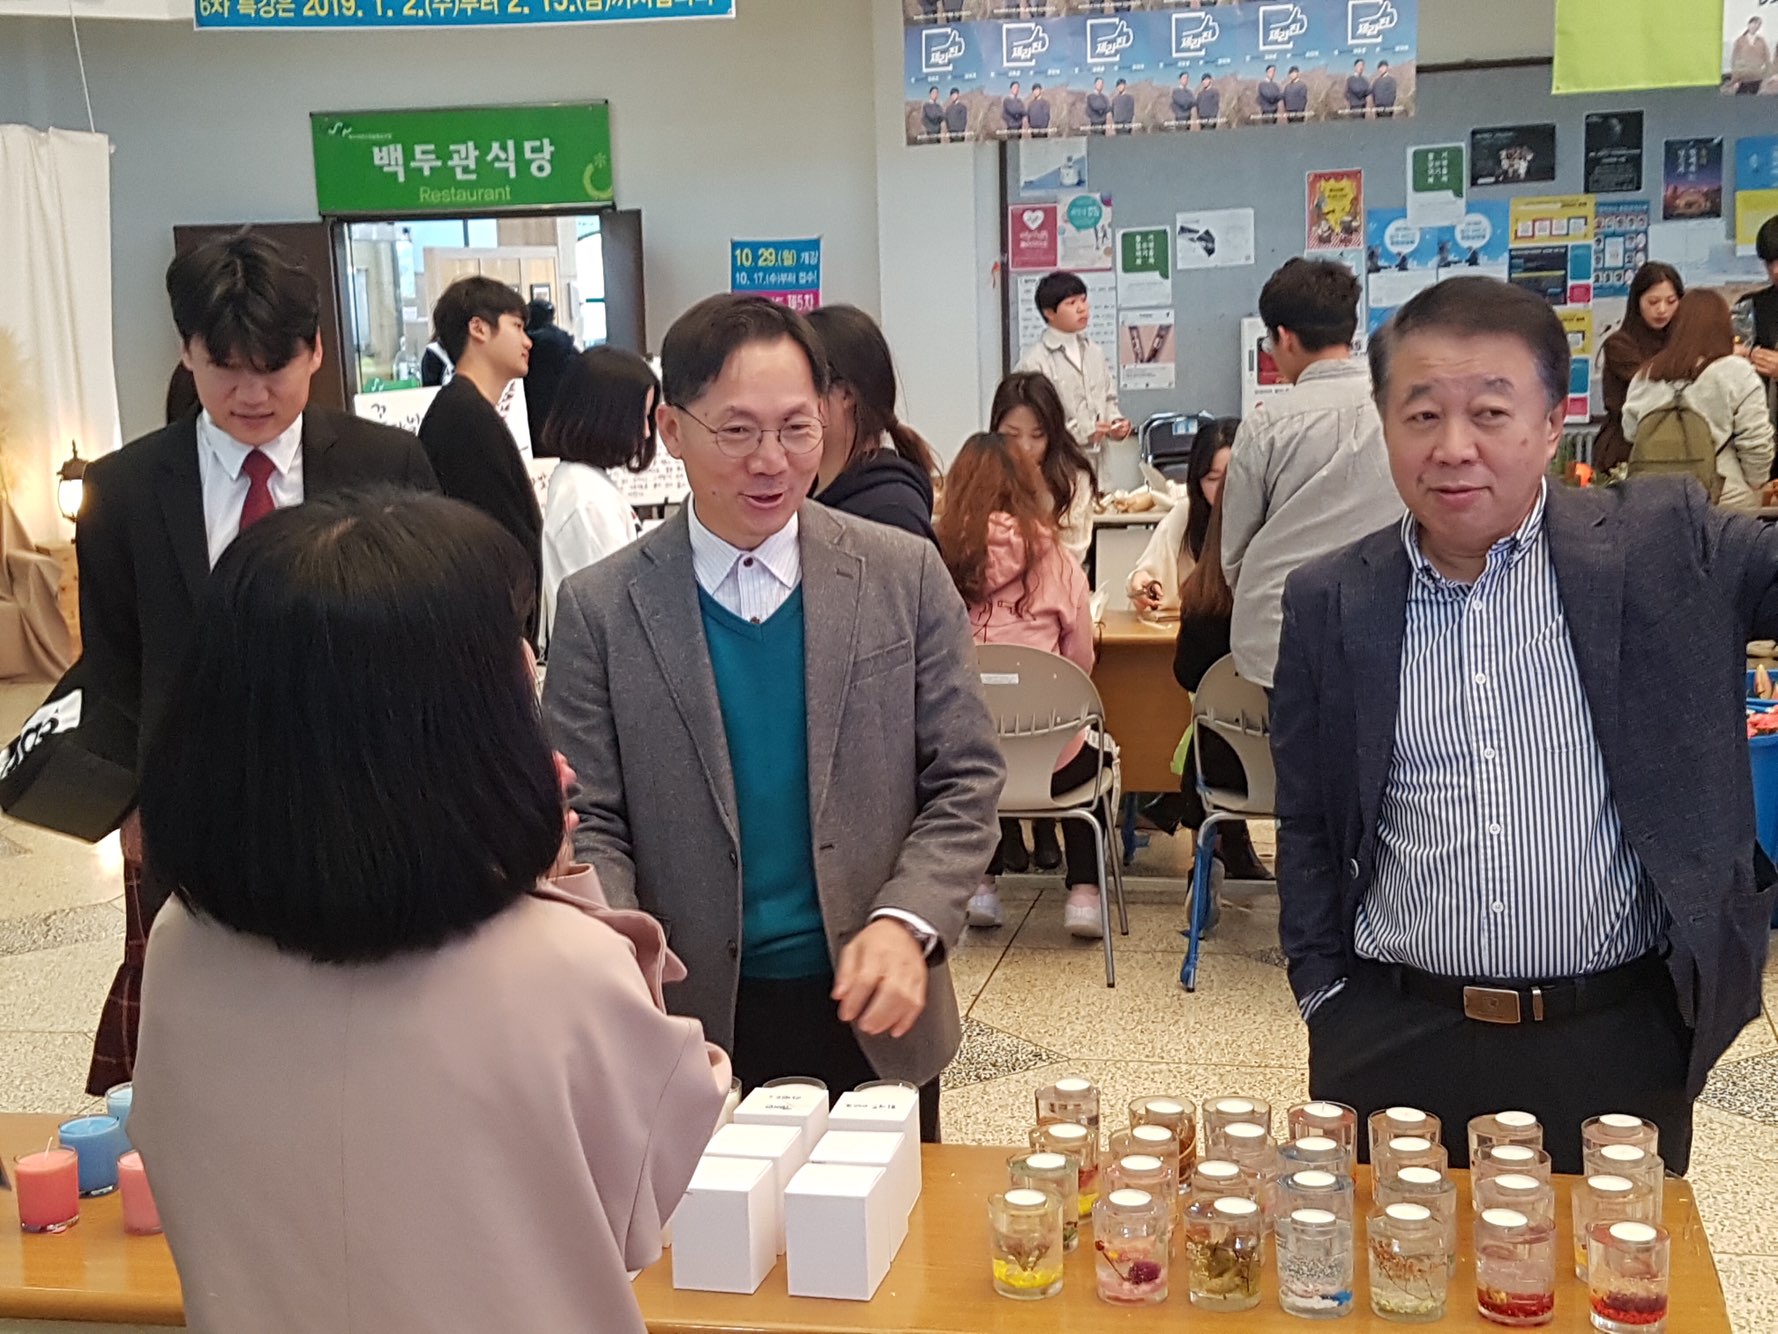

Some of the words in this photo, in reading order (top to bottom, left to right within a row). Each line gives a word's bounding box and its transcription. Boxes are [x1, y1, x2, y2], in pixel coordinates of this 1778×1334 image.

[303, 0, 363, 17] 2019.
[372, 138, 555, 183] 백두관식당
[419, 185, 512, 202] Restaurant
[735, 247, 754, 267] 10.
[735, 271, 750, 285] 10.
